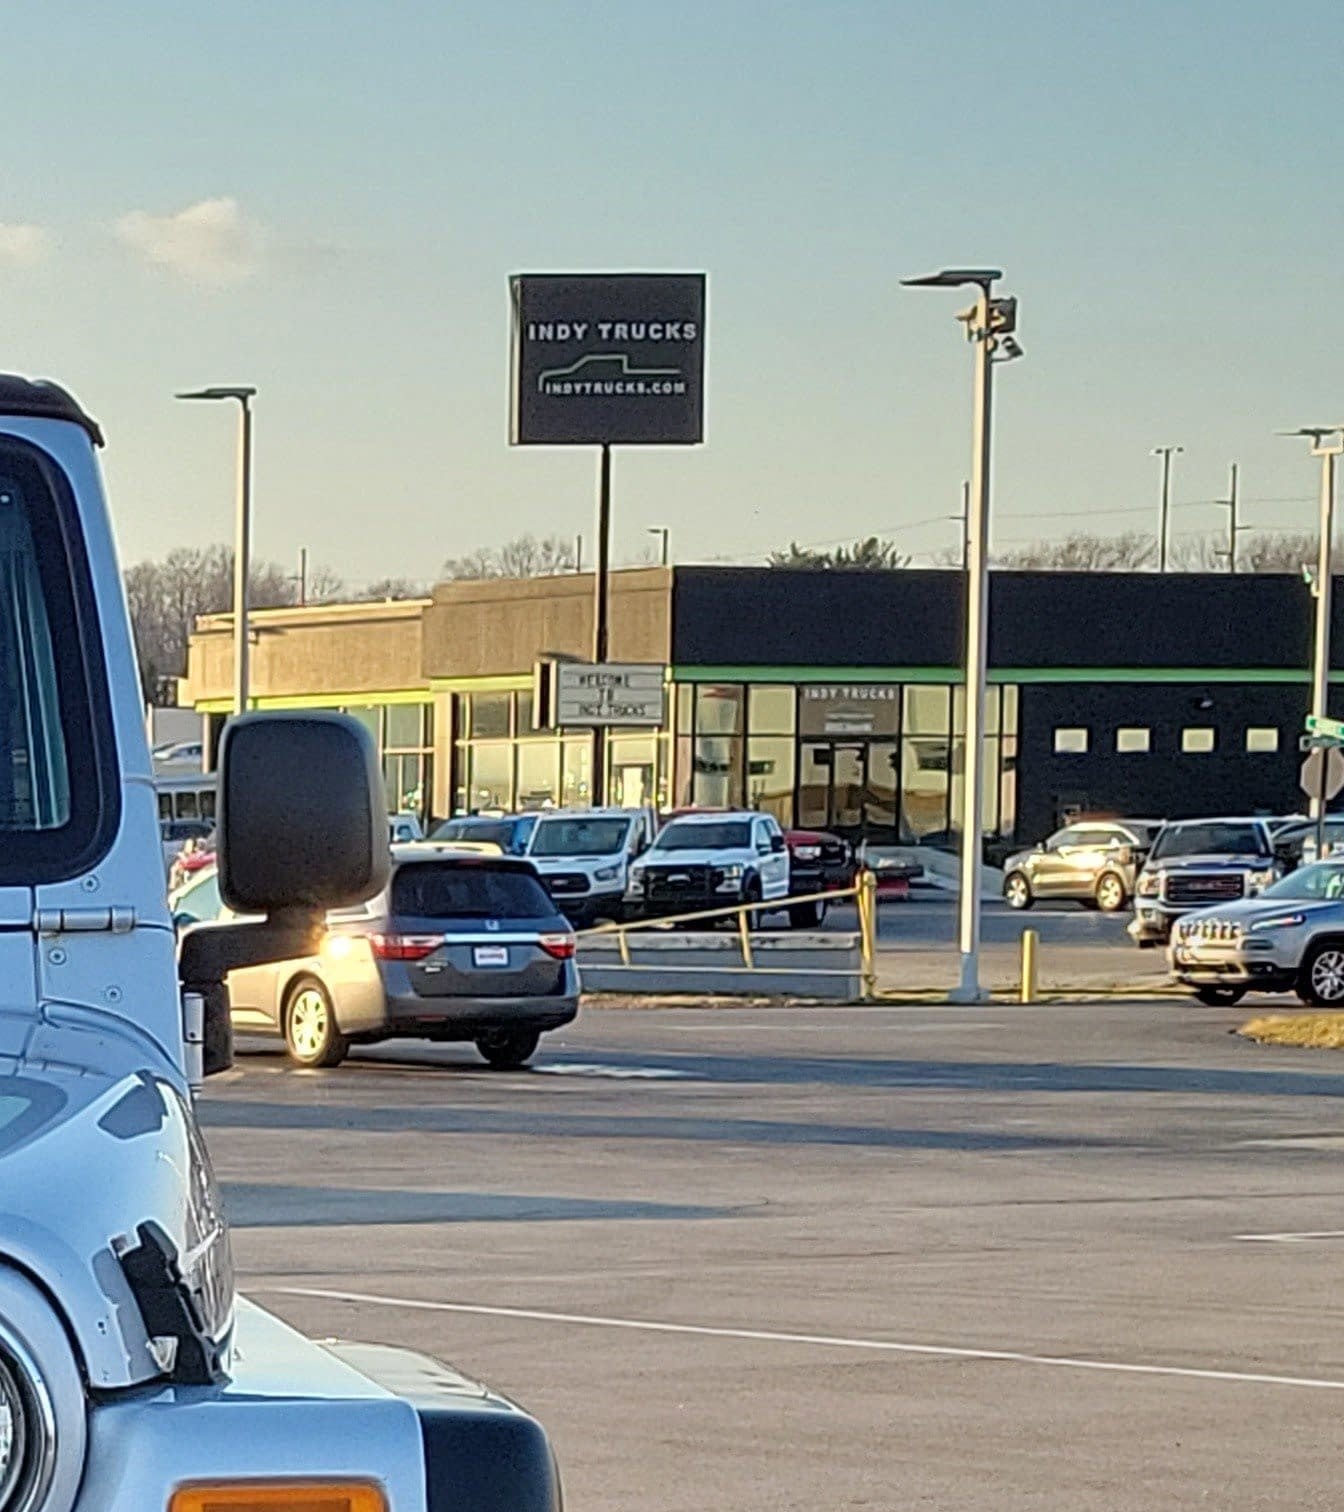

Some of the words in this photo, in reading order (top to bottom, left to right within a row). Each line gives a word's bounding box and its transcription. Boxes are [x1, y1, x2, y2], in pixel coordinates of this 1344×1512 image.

[528, 323, 587, 340] INDY
[598, 322, 696, 339] TRUCKS
[545, 382, 685, 394] INDYTRUCKS.COM
[804, 687, 838, 700] INDY
[842, 687, 895, 700] TRUCKS
